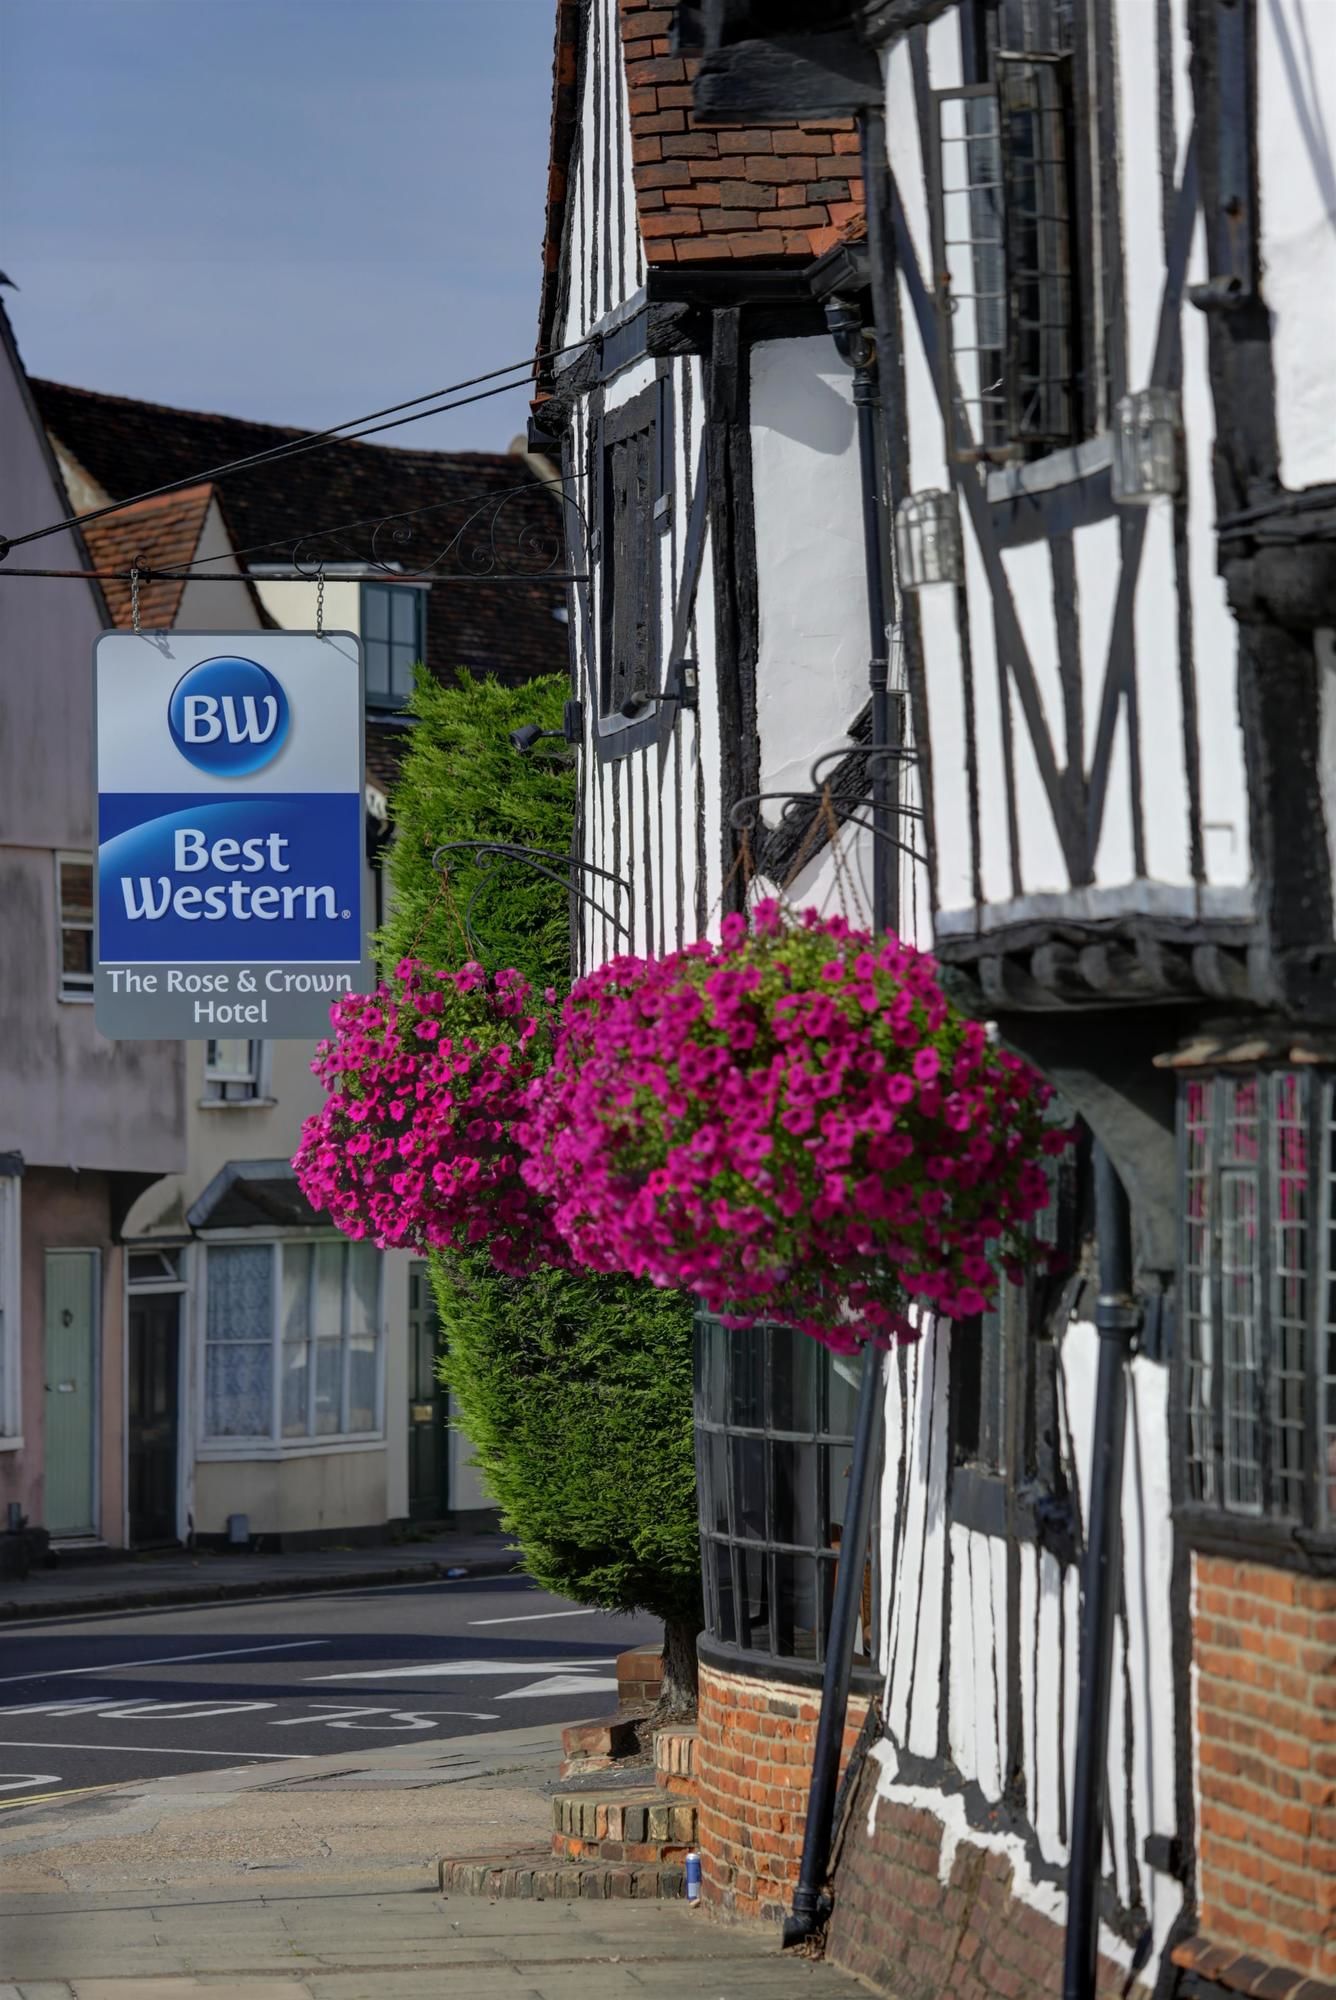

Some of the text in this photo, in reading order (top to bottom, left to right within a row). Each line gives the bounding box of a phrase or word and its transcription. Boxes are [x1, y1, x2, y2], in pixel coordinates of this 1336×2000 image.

[183, 695, 278, 744] BW
[174, 829, 289, 873] Best
[107, 970, 352, 993] The Rose & Crown
[194, 1000, 268, 1024] Hotel
